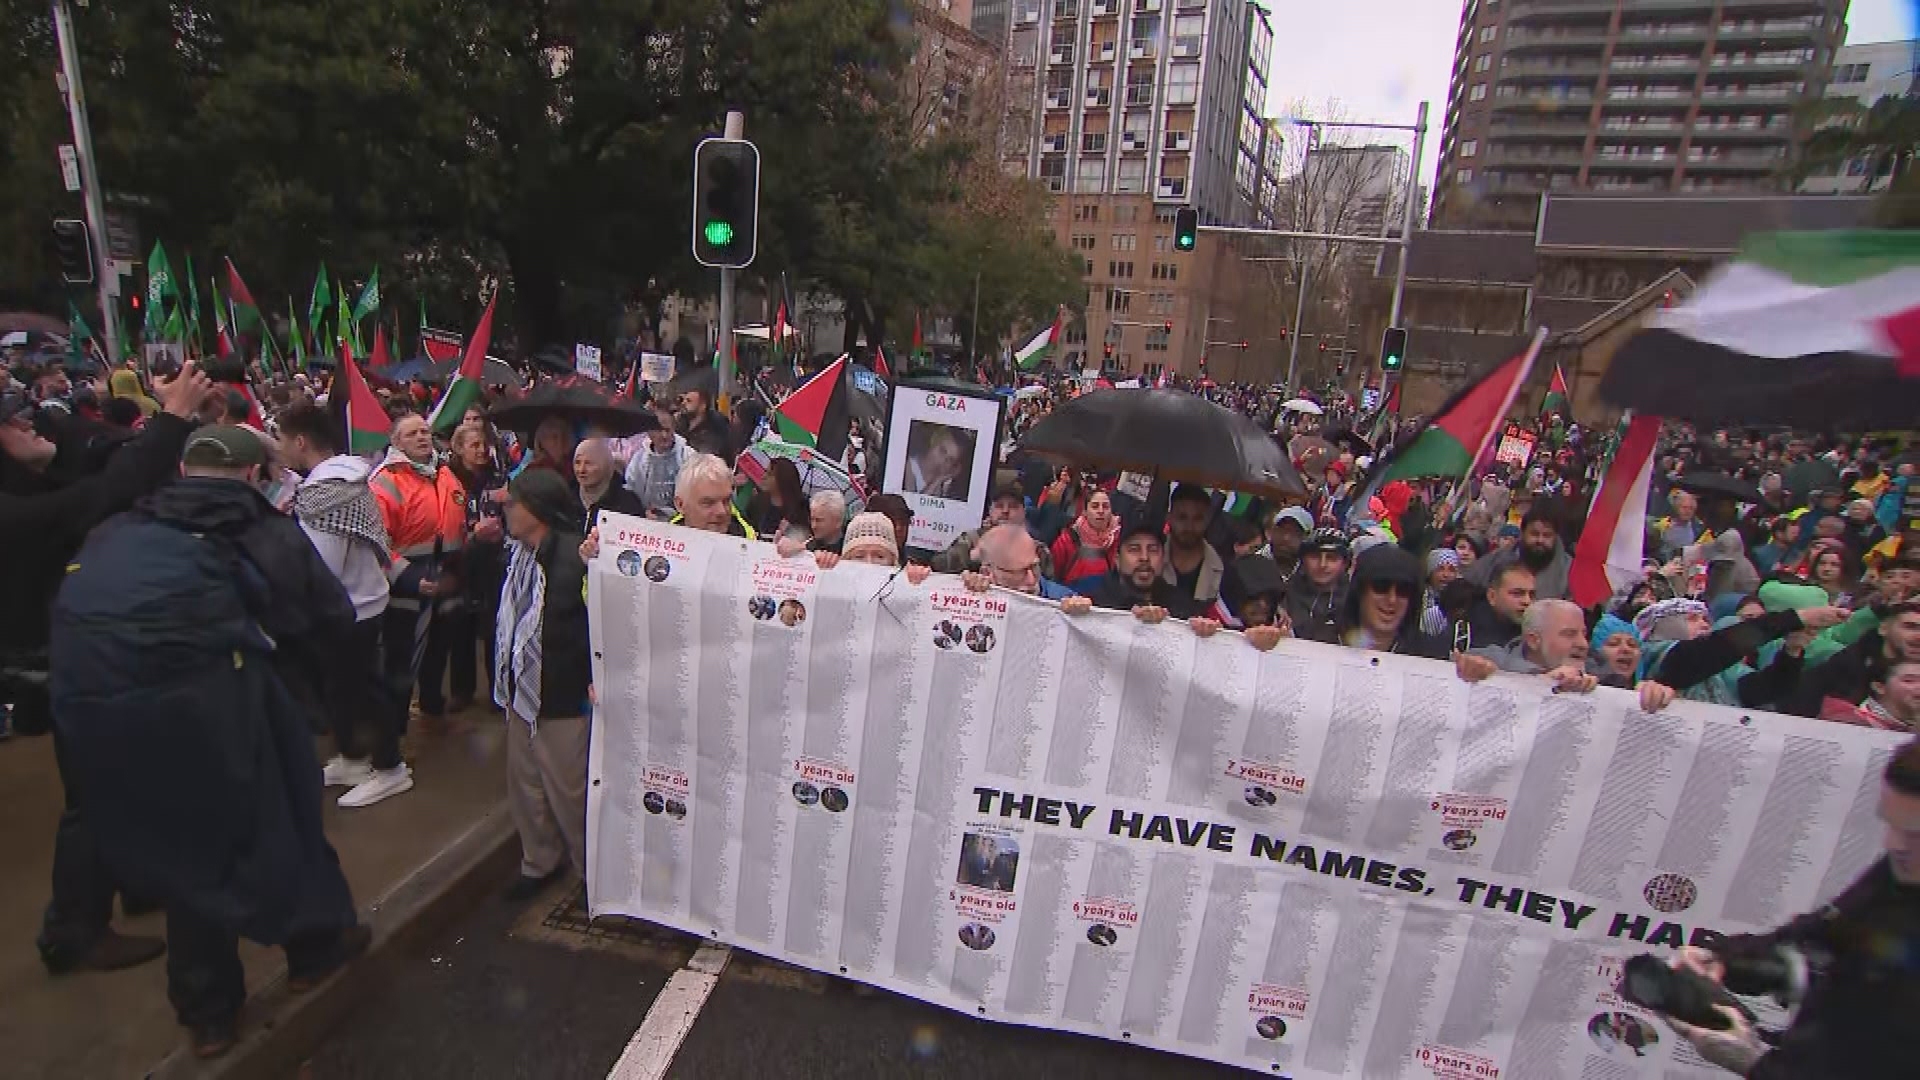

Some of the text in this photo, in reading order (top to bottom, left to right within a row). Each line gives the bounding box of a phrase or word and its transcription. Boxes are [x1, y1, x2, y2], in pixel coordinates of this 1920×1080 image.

[926, 393, 966, 412] GAZA
[919, 497, 945, 509] DIMA
[909, 518, 955, 533] 011-2021
[619, 530, 625, 540] 0
[629, 531, 661, 548] YEARS
[664, 539, 685, 552] OLD
[752, 564, 760, 574] 2
[761, 567, 793, 581] years
[796, 571, 816, 585] old
[930, 592, 1007, 613] 4 years old
[649, 771, 671, 783] year
[673, 777, 689, 787] old
[794, 760, 800, 770] 3
[804, 765, 833, 779] years
[836, 772, 855, 784] old
[1227, 759, 1236, 770] 7
[1239, 765, 1278, 781] years
[1281, 775, 1305, 789] old
[1430, 801, 1506, 821] 9 years old
[973, 787, 1096, 829] THEY
[1108, 809, 1236, 852] HAVE
[1250, 833, 1436, 896] NAMES,
[1456, 877, 1596, 930] THEY
[949, 891, 955, 901] 5
[959, 894, 993, 909] years
[996, 900, 1016, 912] old
[1073, 902, 1080, 913] 6
[1083, 903, 1115, 919] years
[1118, 911, 1138, 923] old
[1257, 995, 1285, 1009] years
[1288, 1001, 1306, 1013] old
[1415, 1049, 1431, 1061] 10
[1434, 1053, 1472, 1071] years
[1475, 1062, 1500, 1079] old
